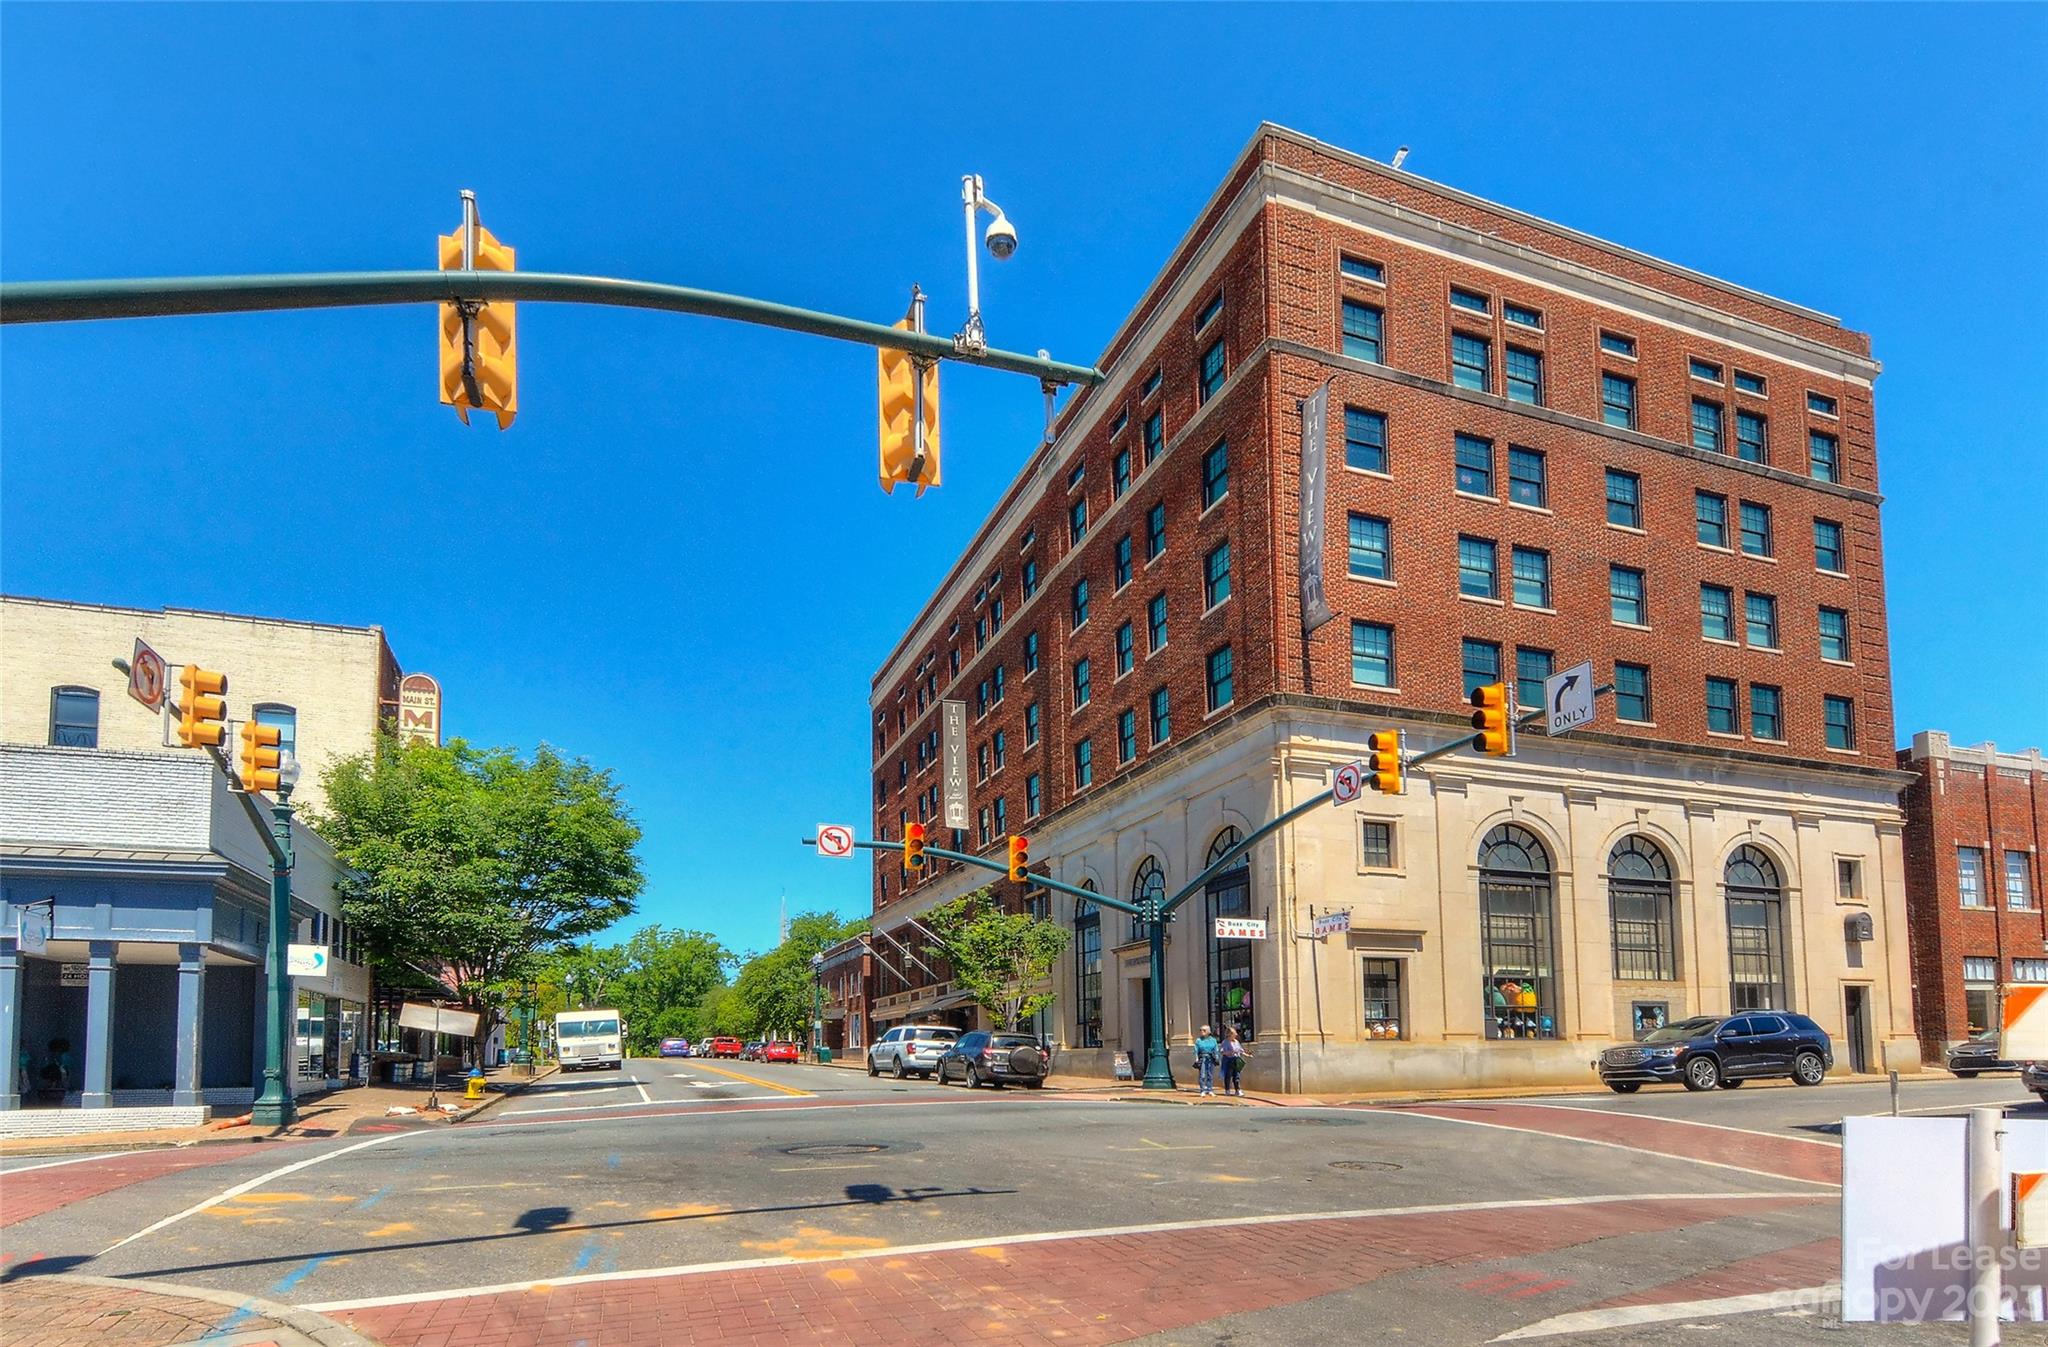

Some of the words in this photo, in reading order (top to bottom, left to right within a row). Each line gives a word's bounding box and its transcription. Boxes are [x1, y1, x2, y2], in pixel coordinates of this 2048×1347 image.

[1308, 395, 1320, 452] THE
[1303, 466, 1318, 547] VIEW
[402, 695, 422, 704] MAIN
[424, 696, 436, 706] ST.
[949, 704, 959, 736] THE
[1554, 705, 1587, 728] ONLY
[949, 744, 962, 787] VIEW
[1217, 928, 1265, 937] GAMES
[1314, 921, 1350, 935] GAMES
